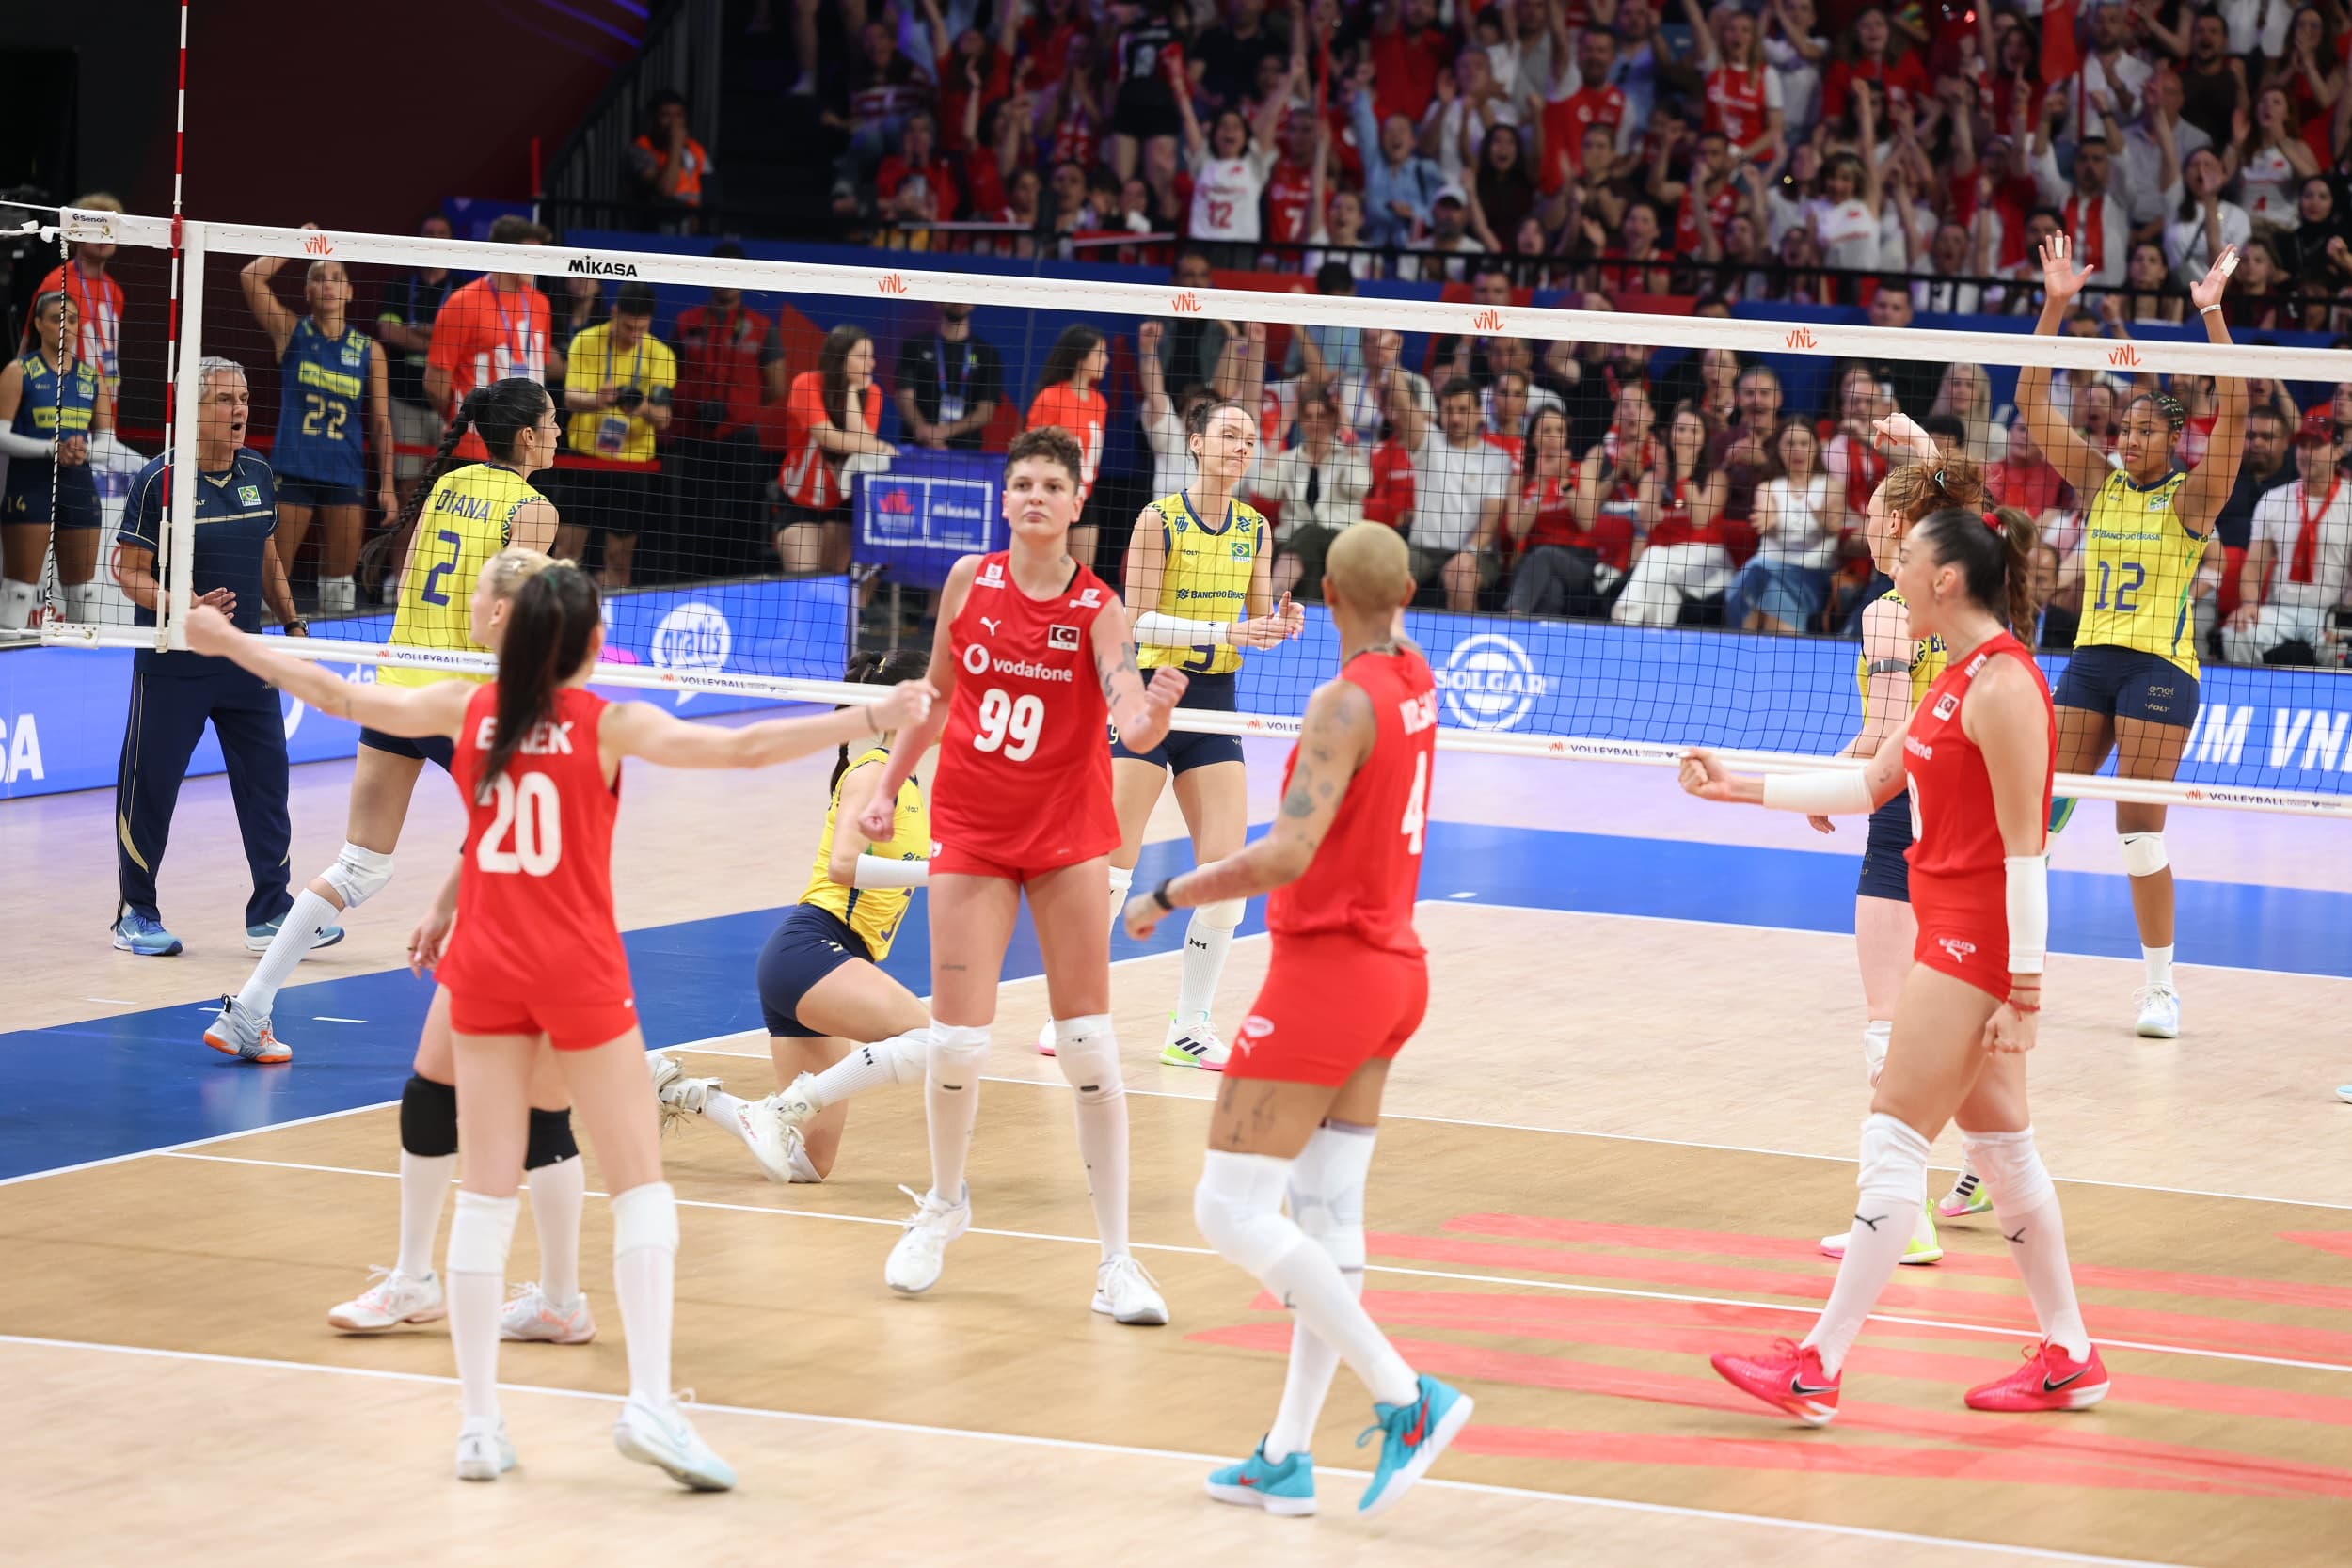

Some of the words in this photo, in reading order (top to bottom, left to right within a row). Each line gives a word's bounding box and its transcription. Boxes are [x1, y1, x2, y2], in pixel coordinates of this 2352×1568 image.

[80, 214, 107, 223] Senoh
[301, 392, 348, 441] 22
[435, 488, 491, 524] DIANA
[421, 528, 462, 607] 2
[2094, 561, 2145, 611] 12
[662, 615, 722, 668] gratis
[993, 658, 1073, 683] vodafone
[1434, 667, 1547, 697] SOLGAR
[973, 688, 1044, 762] 99
[1267, 721, 1302, 731] VOLLE
[1570, 744, 1641, 757] VOLLEYBALL
[1401, 750, 1428, 856] 4
[2210, 792, 2285, 806] VOLLEYBALL
[475, 771, 563, 877] 20
